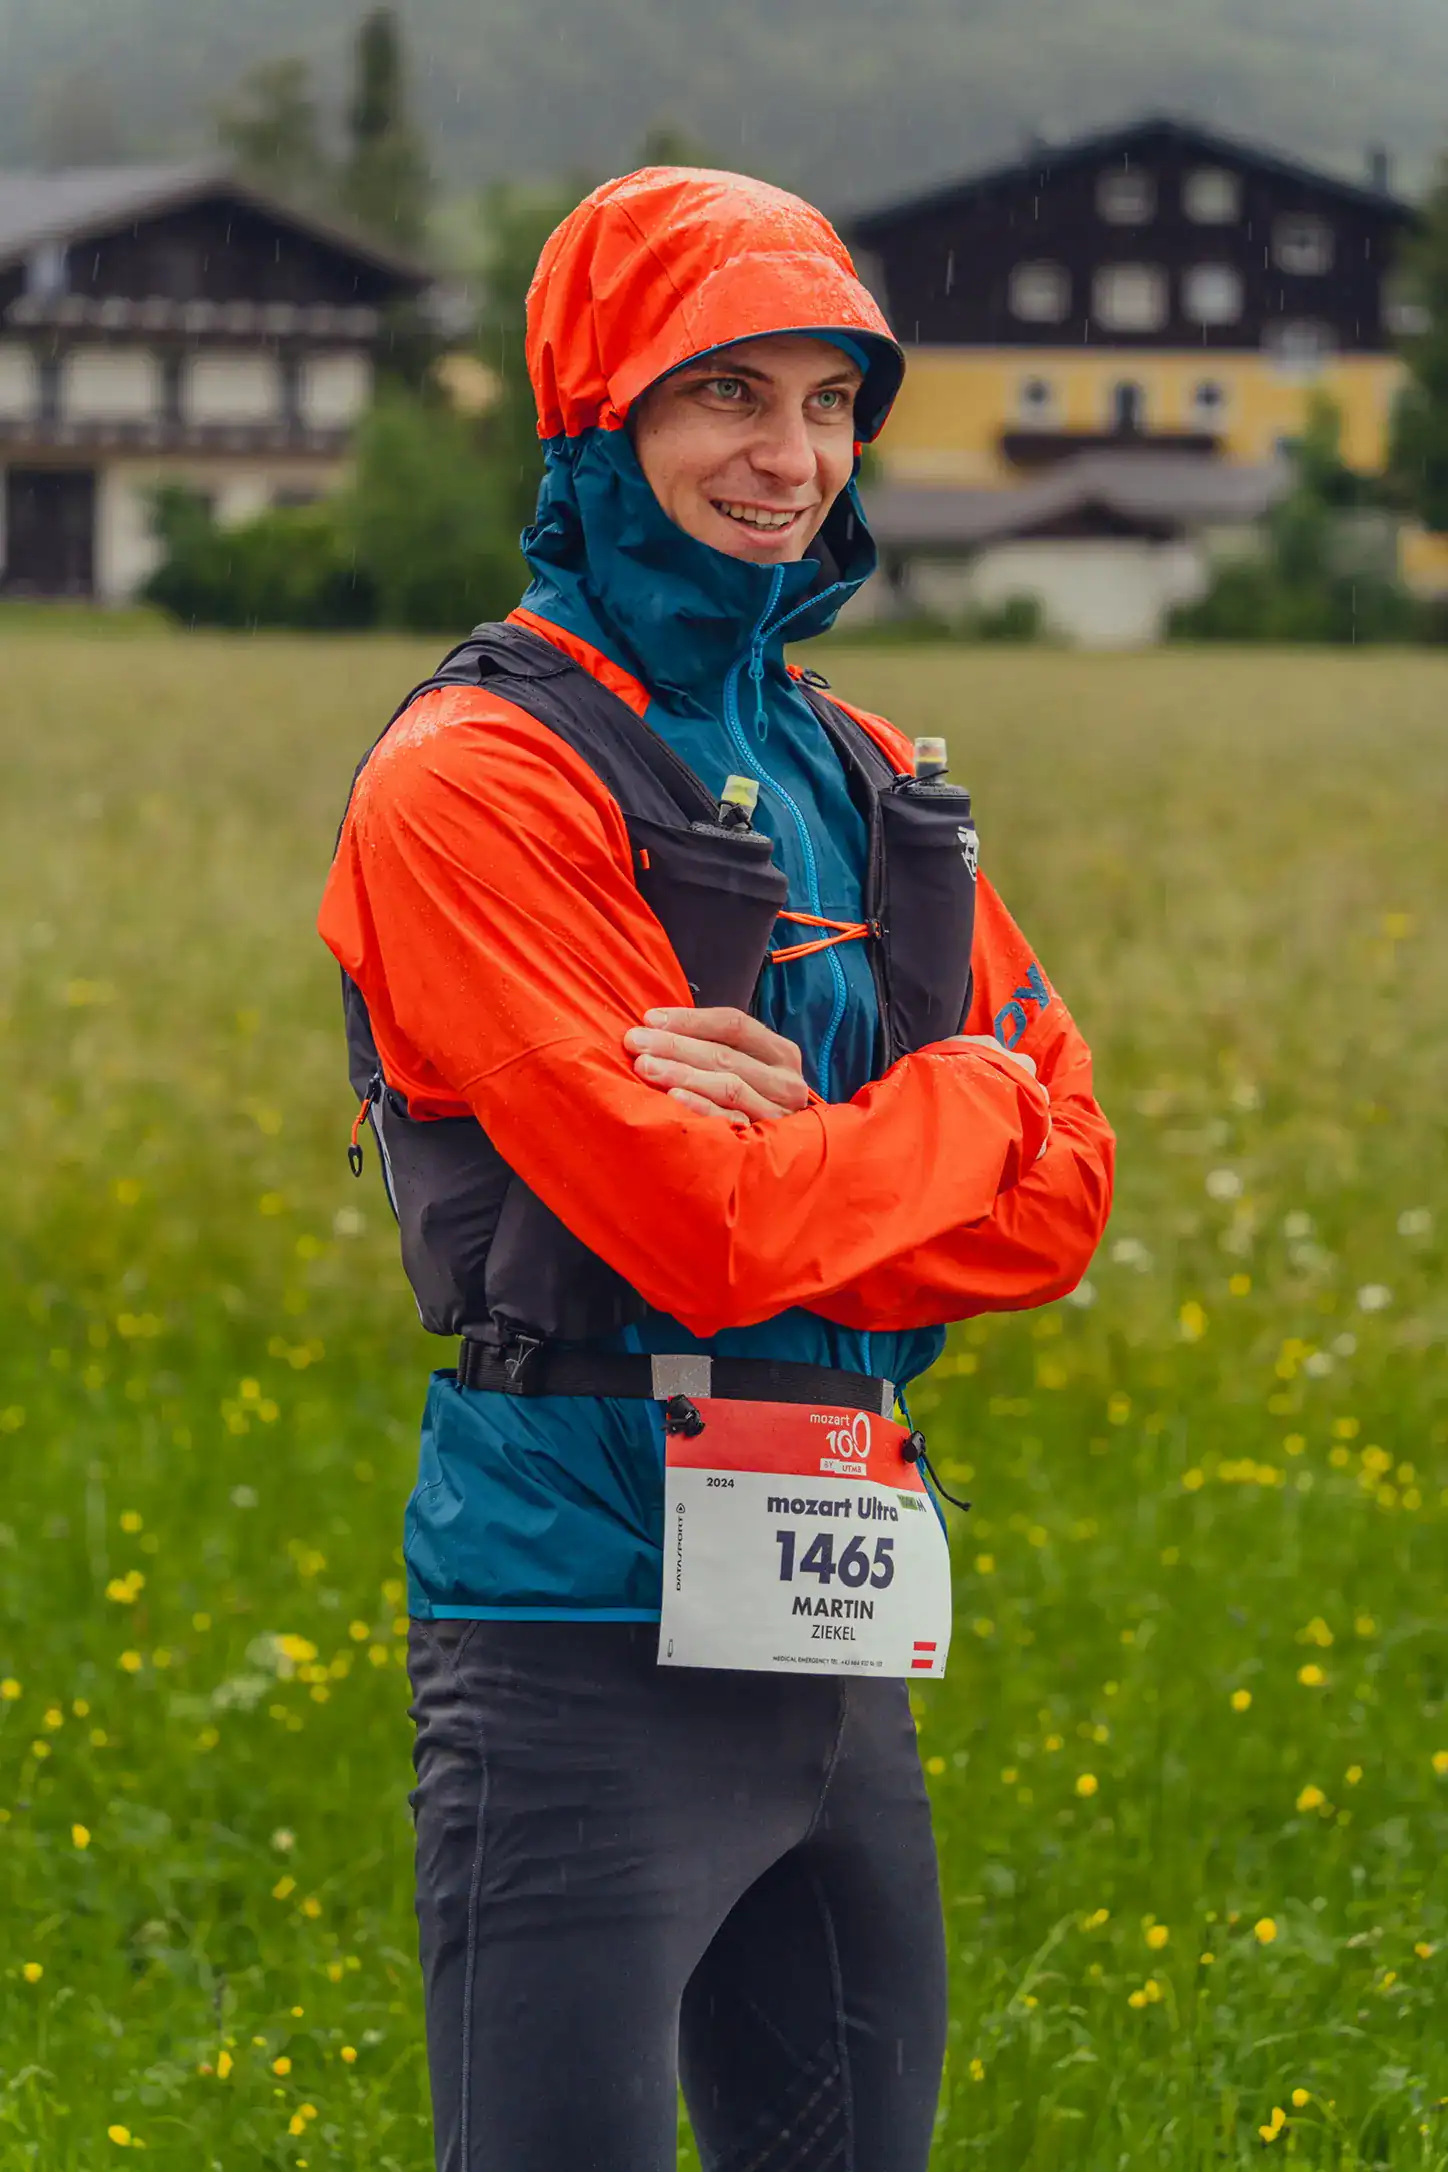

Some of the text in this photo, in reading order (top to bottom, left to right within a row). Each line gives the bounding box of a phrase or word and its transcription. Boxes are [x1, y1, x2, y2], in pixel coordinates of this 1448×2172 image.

[810, 1413, 850, 1427] mozart
[826, 1412, 871, 1458] 100
[824, 1461, 862, 1473] BY UTMB
[706, 1477, 735, 1488] 2024
[767, 1496, 852, 1518] mozart
[857, 1497, 899, 1522] Ultra
[676, 1516, 684, 1591] DATASPORT
[776, 1530, 895, 1590] 1465
[792, 1596, 874, 1620] MARTIN
[811, 1624, 856, 1641] ZIEKEL
